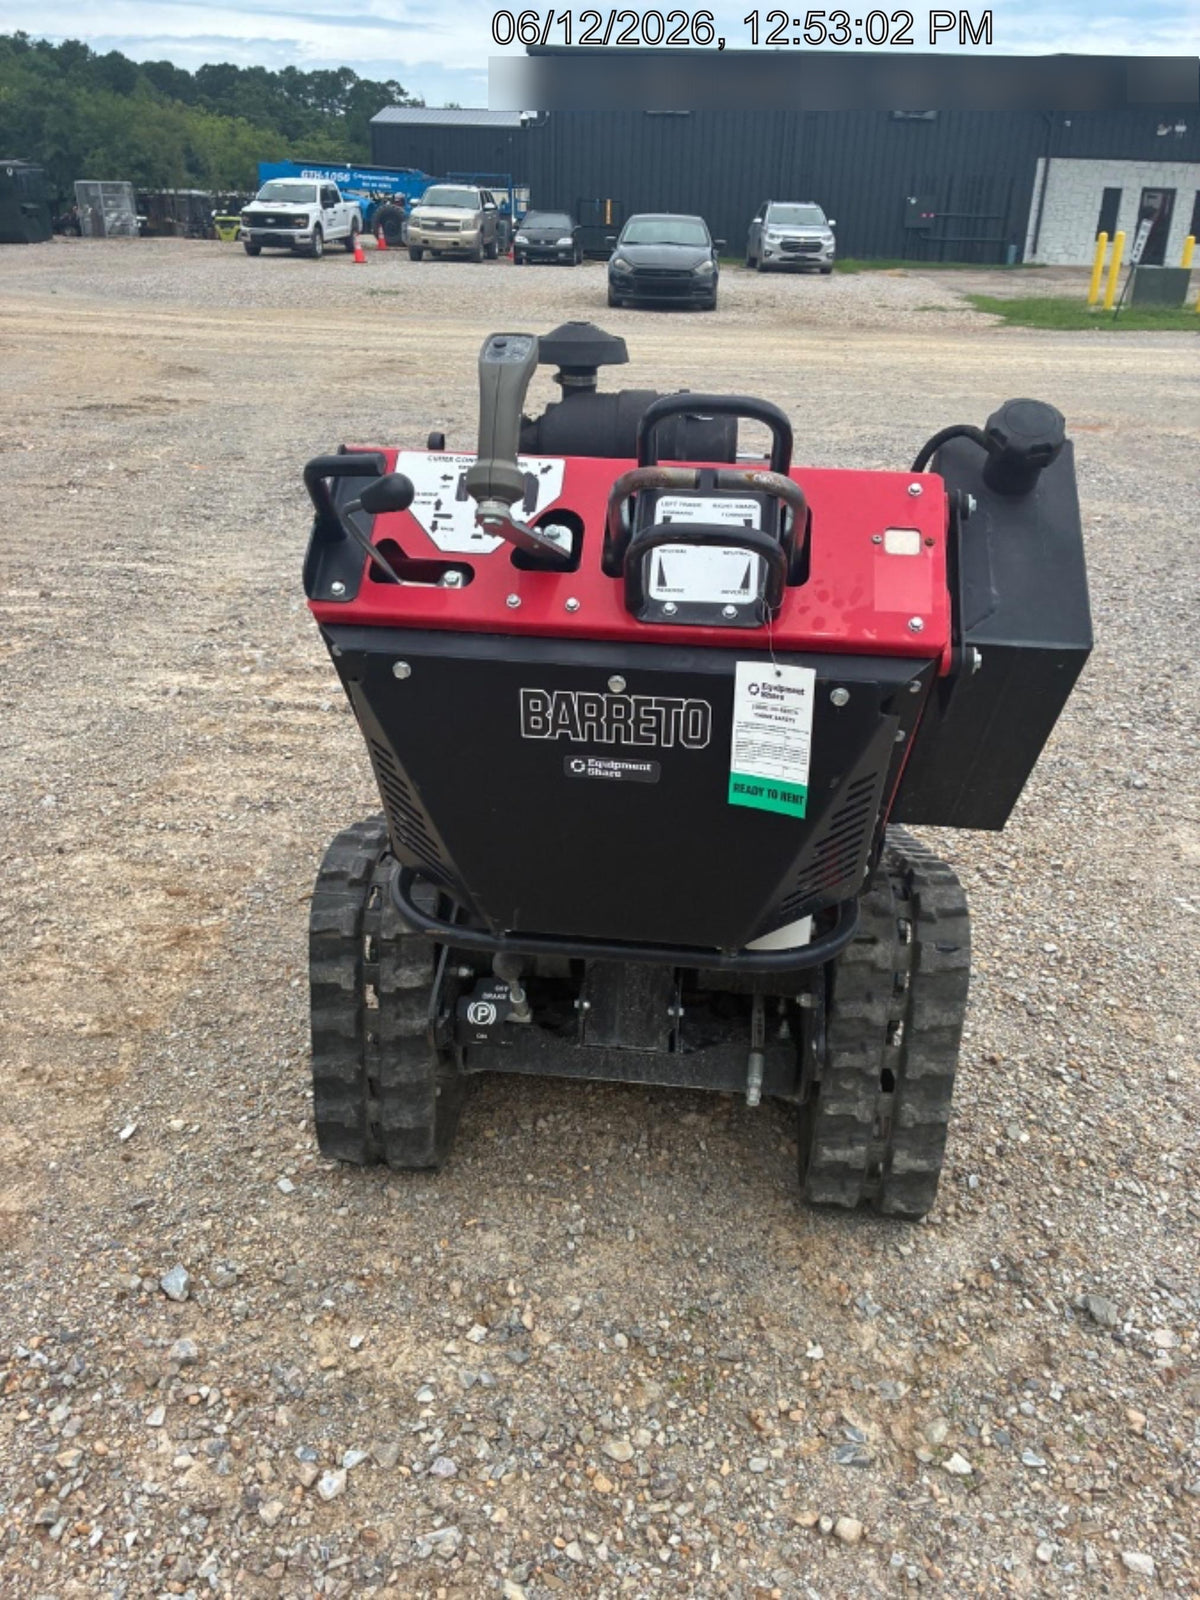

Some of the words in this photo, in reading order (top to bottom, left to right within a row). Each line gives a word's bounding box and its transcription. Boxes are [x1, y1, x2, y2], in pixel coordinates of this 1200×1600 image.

[760, 690, 785, 700] Share
[761, 682, 805, 697] Equipment
[520, 688, 712, 749] BARRETO
[587, 758, 653, 771] Equipment
[587, 767, 622, 778] Share
[733, 781, 765, 798] READY
[767, 787, 779, 801] TO
[780, 790, 805, 805] RENT
